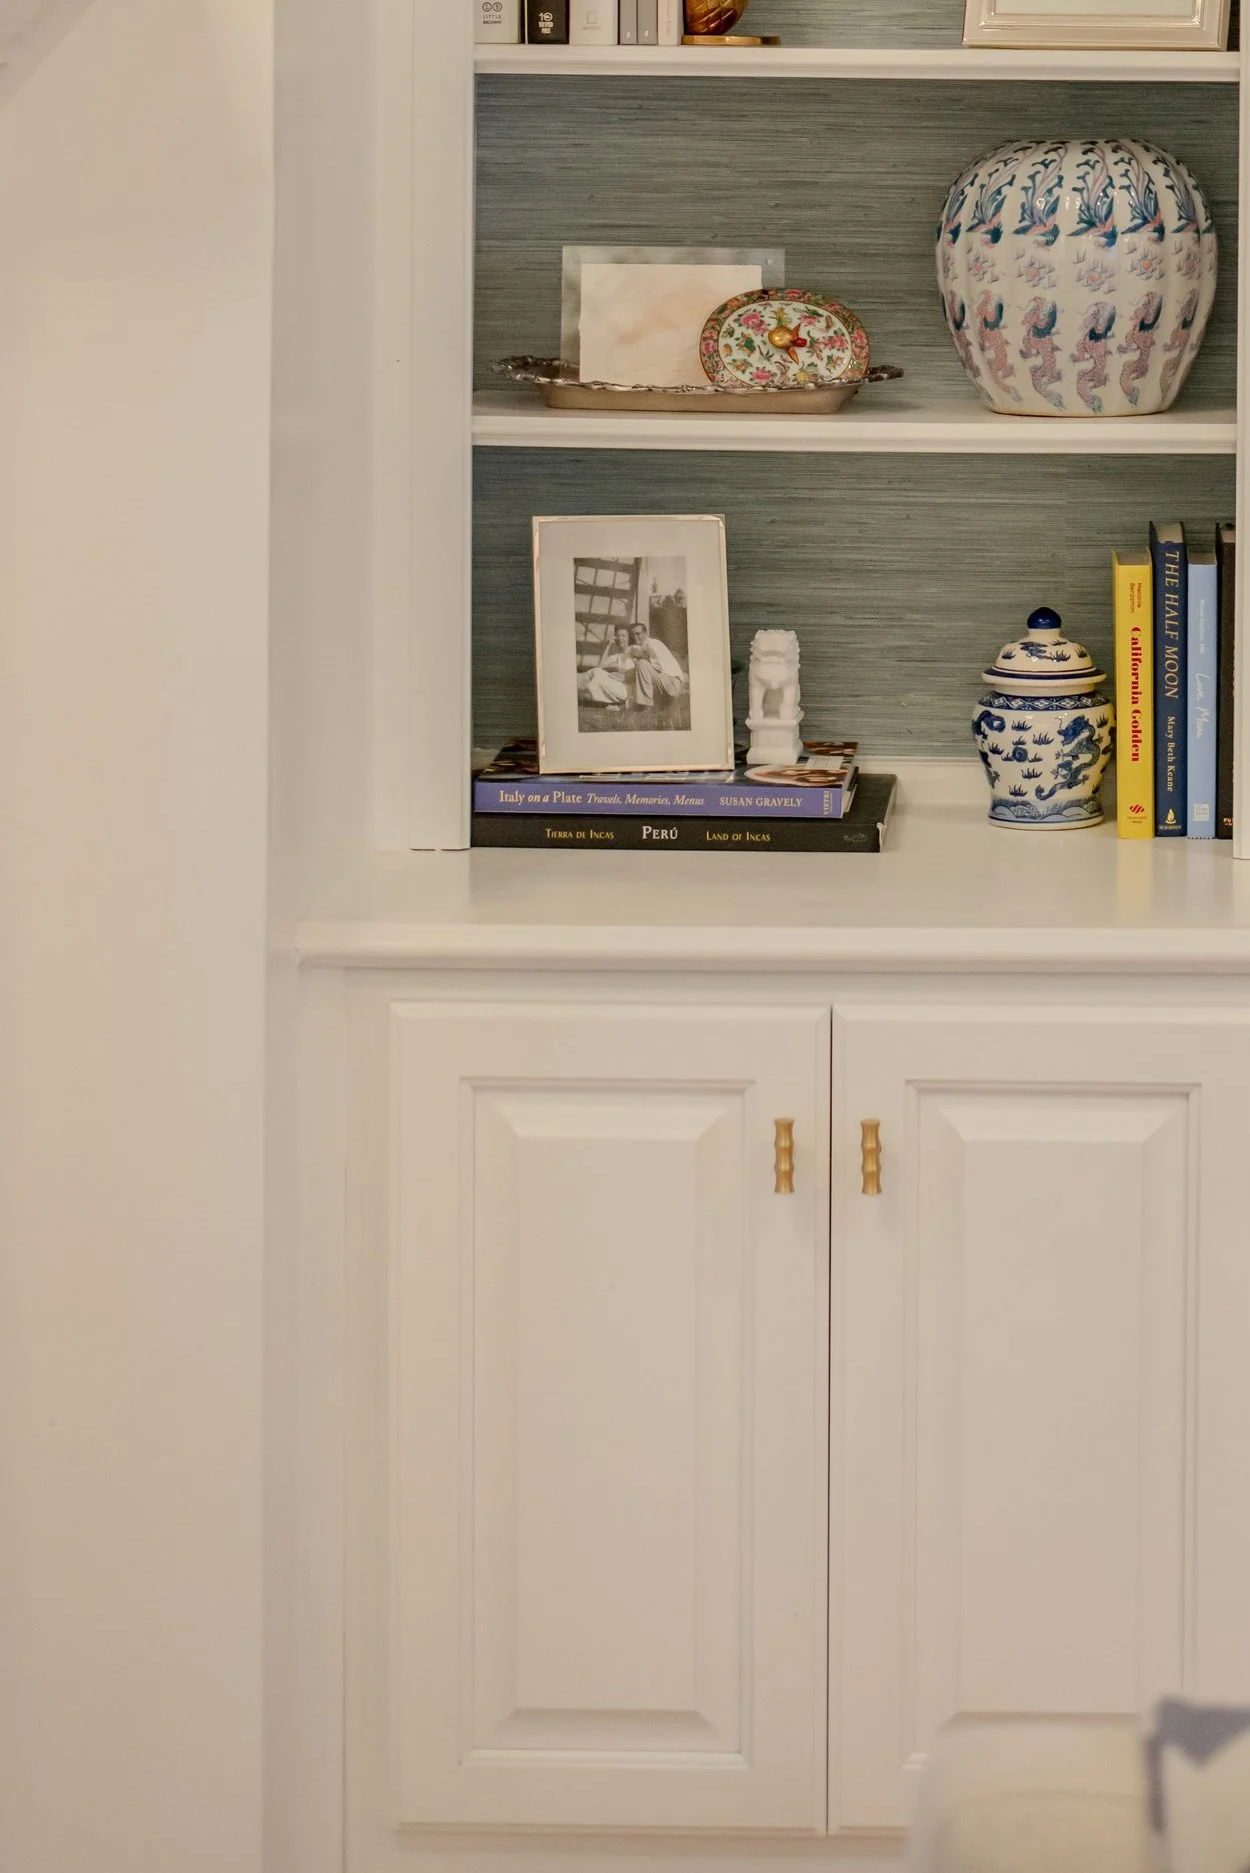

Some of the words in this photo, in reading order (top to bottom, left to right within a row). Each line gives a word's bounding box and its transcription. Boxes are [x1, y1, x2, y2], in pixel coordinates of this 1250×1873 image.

[1165, 551, 1179, 587] THE
[1164, 594, 1179, 640] HALF
[1131, 627, 1143, 705] California
[1164, 646, 1179, 698] MOON
[1131, 709, 1143, 762] Golden
[1165, 716, 1176, 739] Mary
[1167, 742, 1176, 762] Beth
[1167, 765, 1176, 792] Keane
[500, 790, 525, 806] Italy
[528, 795, 542, 803] on
[542, 795, 549, 803] a
[553, 791, 583, 803] Plate
[587, 792, 622, 805] Travels,
[625, 794, 671, 806] Memories,
[674, 795, 704, 805] Menus
[720, 797, 752, 806] SUSAN
[756, 798, 803, 808] GRAVELY
[545, 828, 573, 839] TIERRA
[590, 829, 615, 840] INCAS
[642, 825, 678, 840] PERÚ
[706, 831, 729, 841] LAND
[746, 831, 771, 842] INCAS
